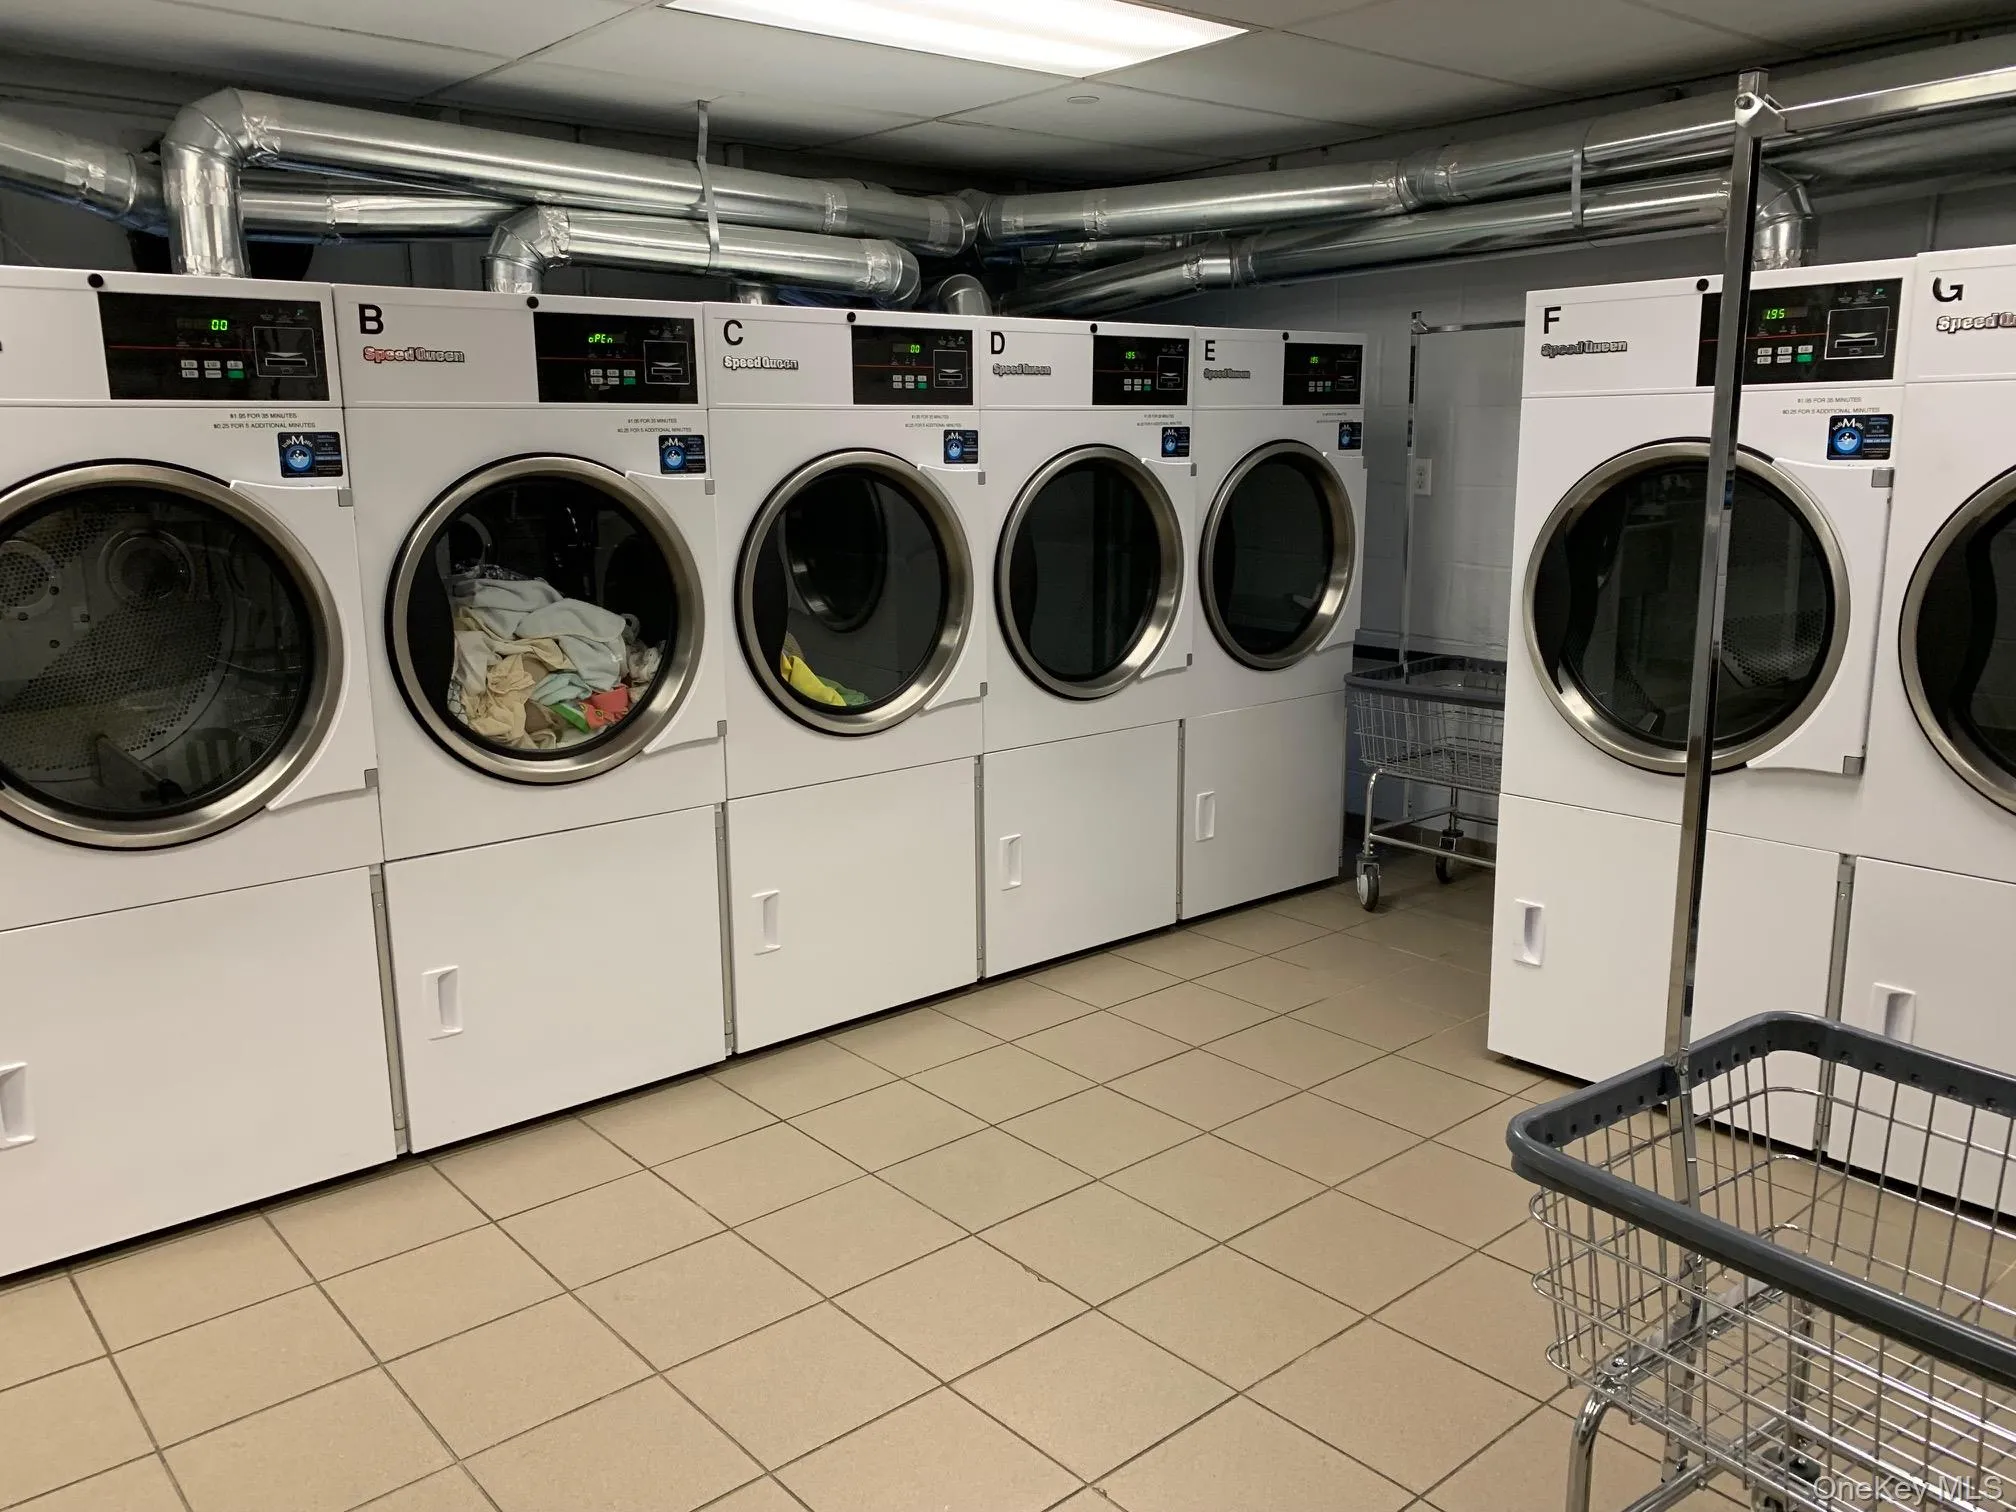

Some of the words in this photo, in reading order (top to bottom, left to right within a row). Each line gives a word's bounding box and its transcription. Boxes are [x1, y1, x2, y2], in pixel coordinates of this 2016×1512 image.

[358, 304, 384, 335] B
[1544, 306, 1562, 335] F
[1937, 313, 1998, 334] Speed
[724, 320, 744, 346] C
[990, 332, 1006, 354] D
[363, 346, 414, 363] Speed
[415, 347, 465, 363] Queen
[1204, 340, 1215, 361] E
[1541, 341, 1584, 358] Speed
[1585, 339, 1628, 354] Queen
[724, 355, 762, 370] Speed
[762, 356, 799, 370] Queen
[993, 363, 1022, 376] Speed
[1022, 364, 1051, 375] Queen
